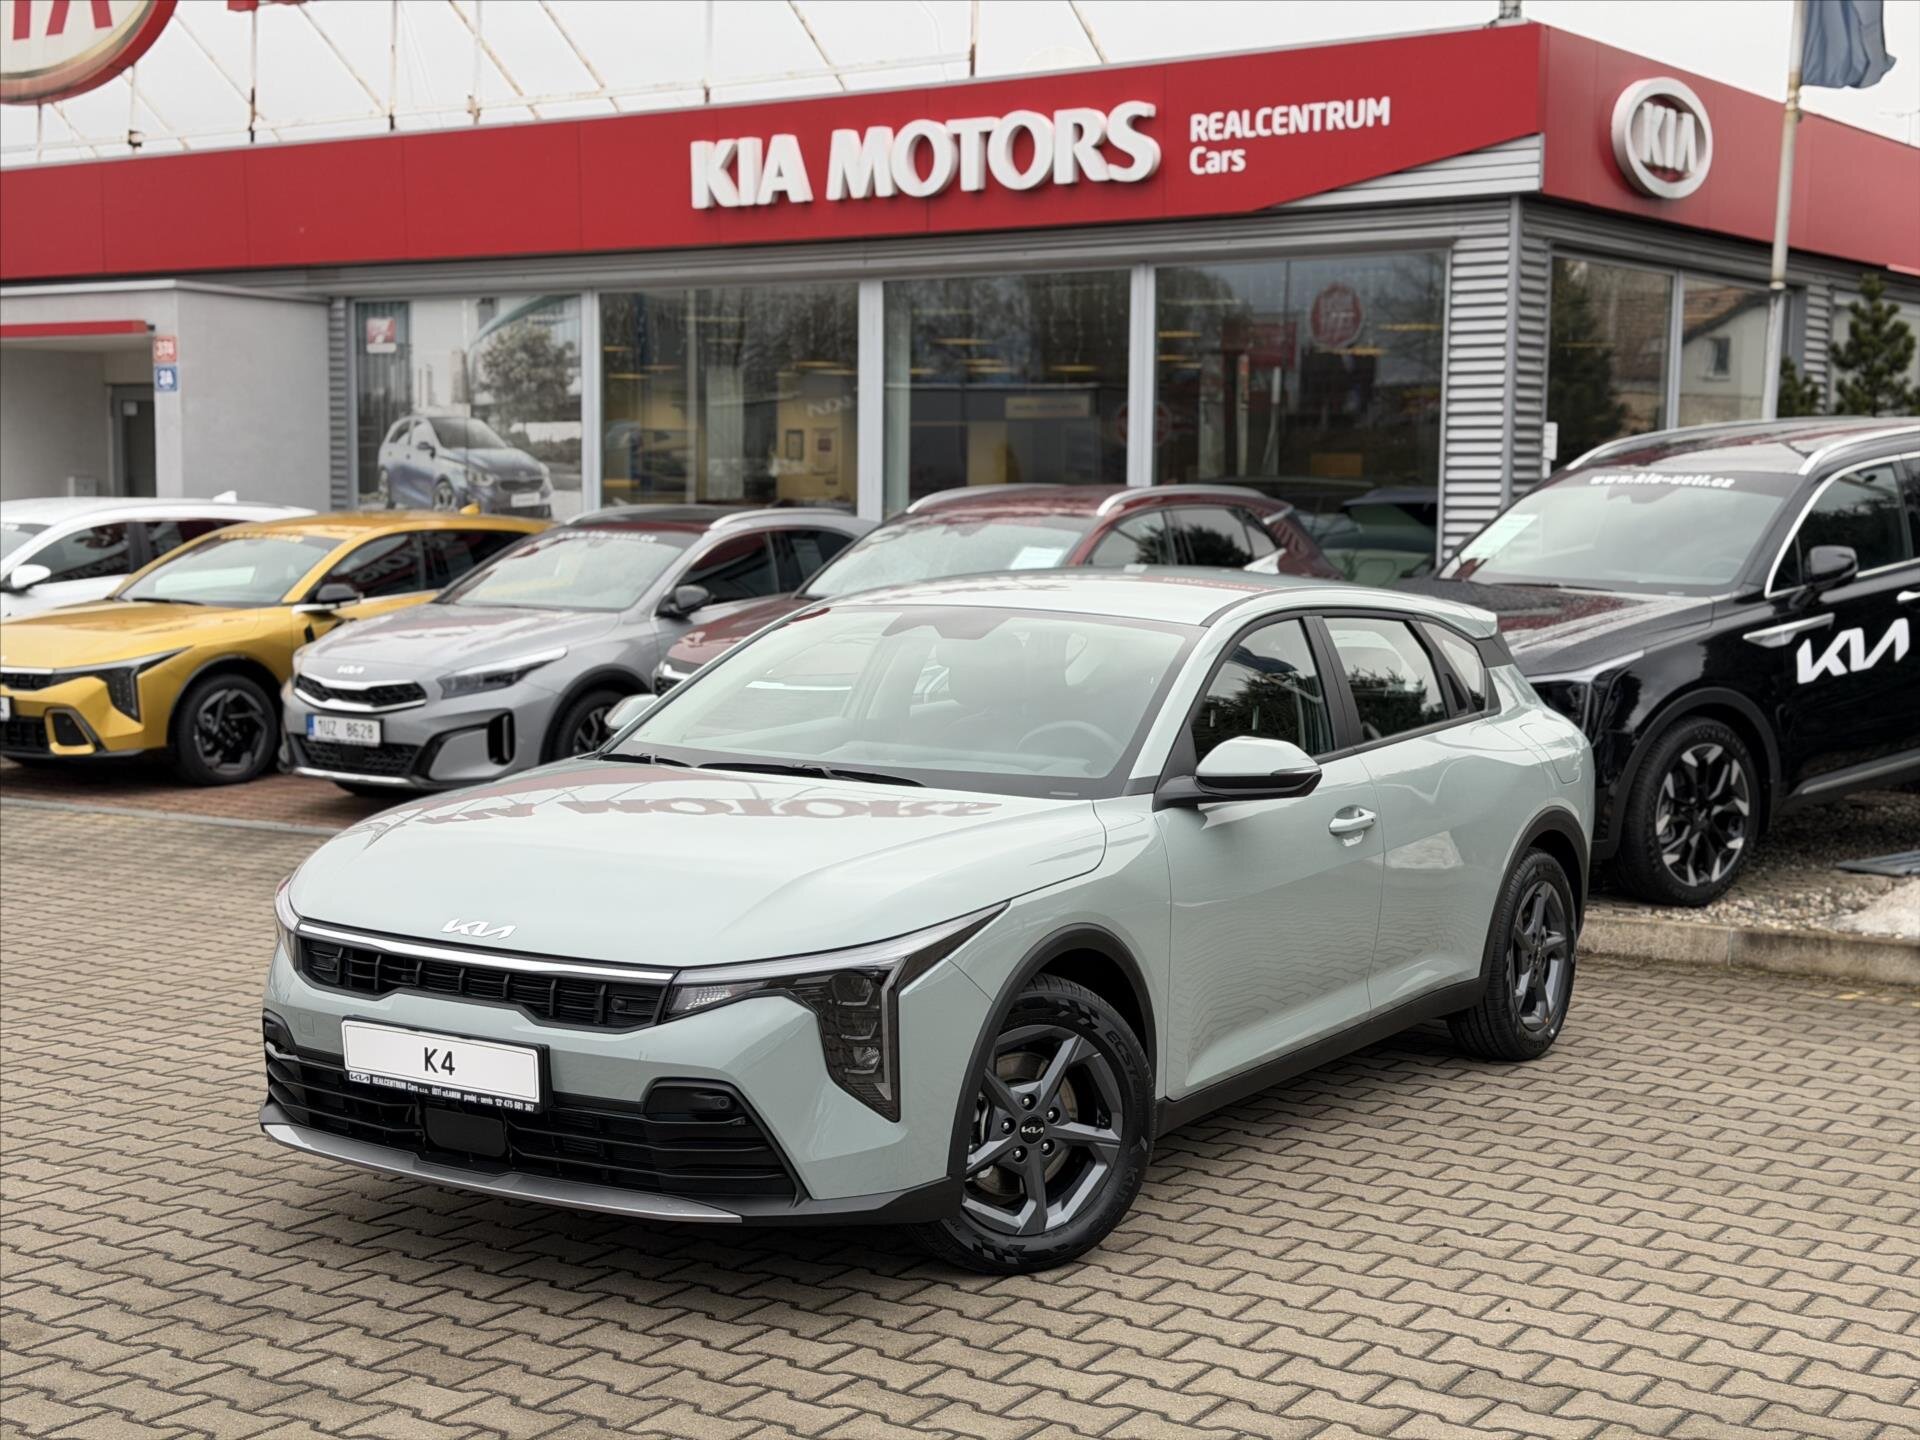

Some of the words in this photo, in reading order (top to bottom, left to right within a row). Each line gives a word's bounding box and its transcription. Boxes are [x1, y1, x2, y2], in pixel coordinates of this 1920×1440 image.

[1190, 96, 1391, 143] REALCENTRUM
[1640, 101, 1698, 174] KIA
[690, 133, 813, 209] KIA
[826, 101, 1161, 201] MOTORS
[1189, 146, 1246, 175] Cars
[1796, 617, 1910, 685] KIA
[318, 719, 337, 736] 1UZ
[346, 722, 375, 739] 8628
[440, 918, 517, 940] KIA
[424, 1046, 456, 1076] K4
